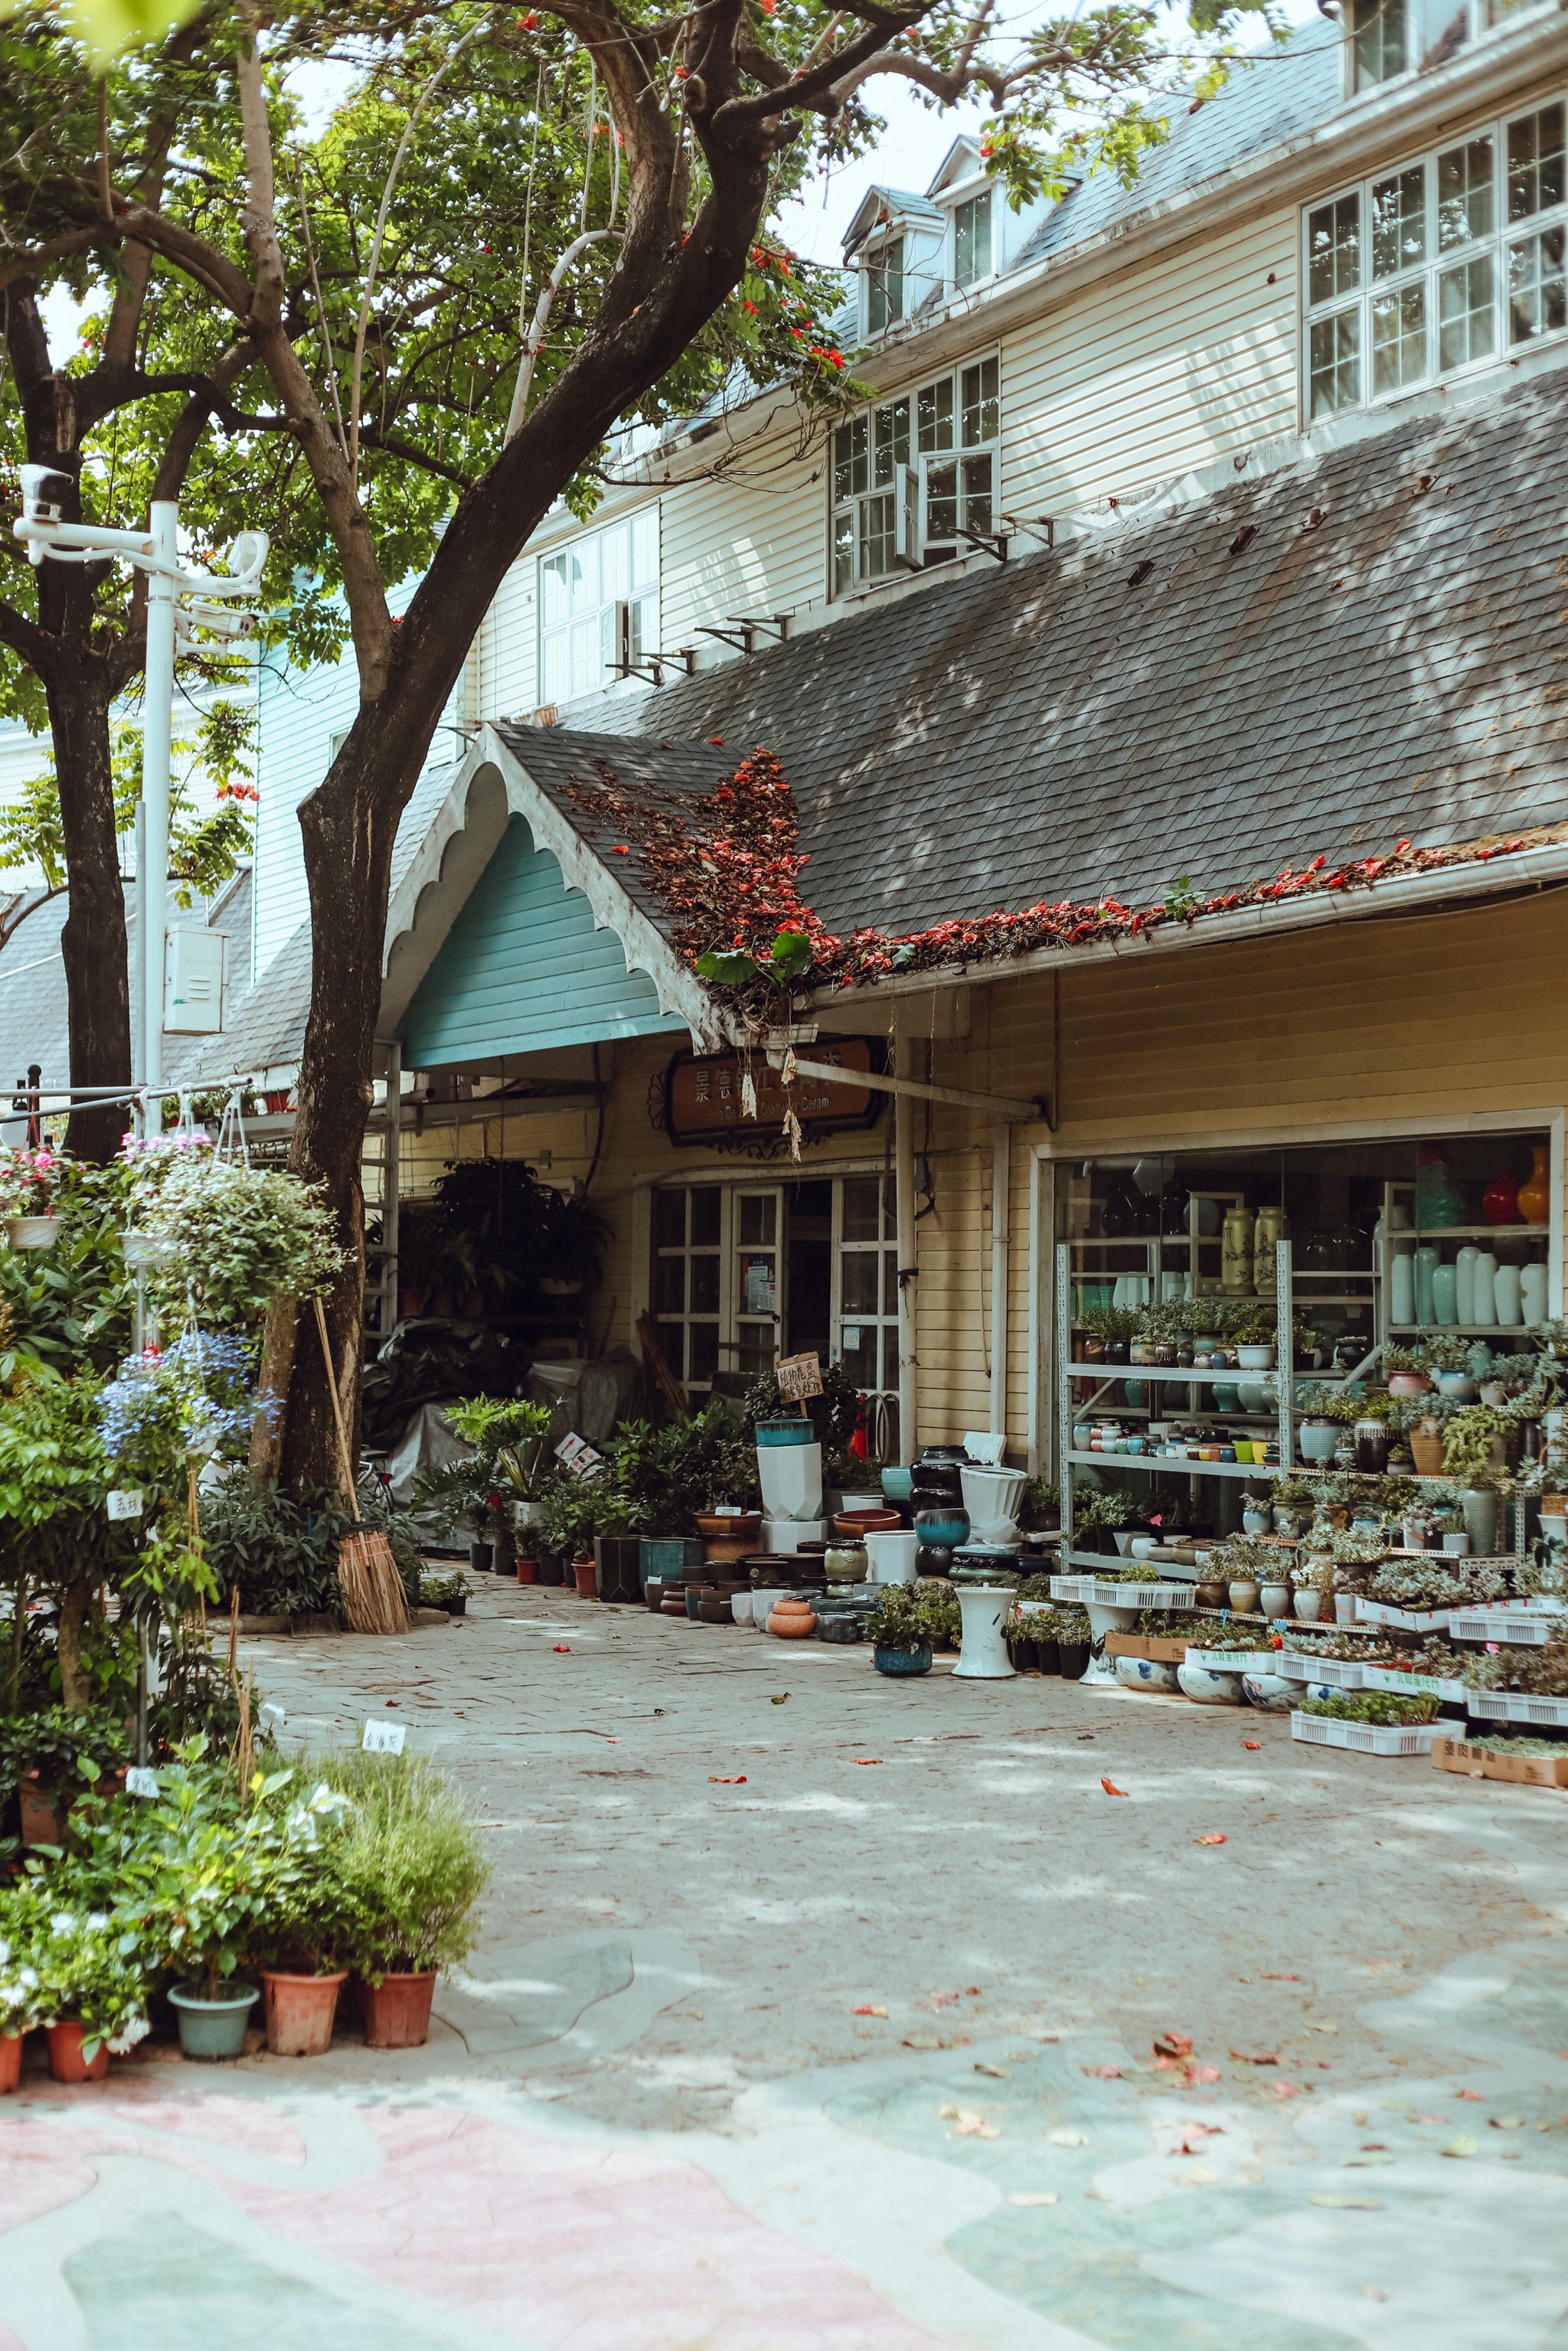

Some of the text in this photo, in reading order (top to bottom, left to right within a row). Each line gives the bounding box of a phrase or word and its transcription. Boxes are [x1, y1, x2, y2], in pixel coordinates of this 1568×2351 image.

[726, 1105, 736, 1119] De
[802, 1096, 829, 1111] Ceram
[116, 1497, 137, 1514] 荔枝
